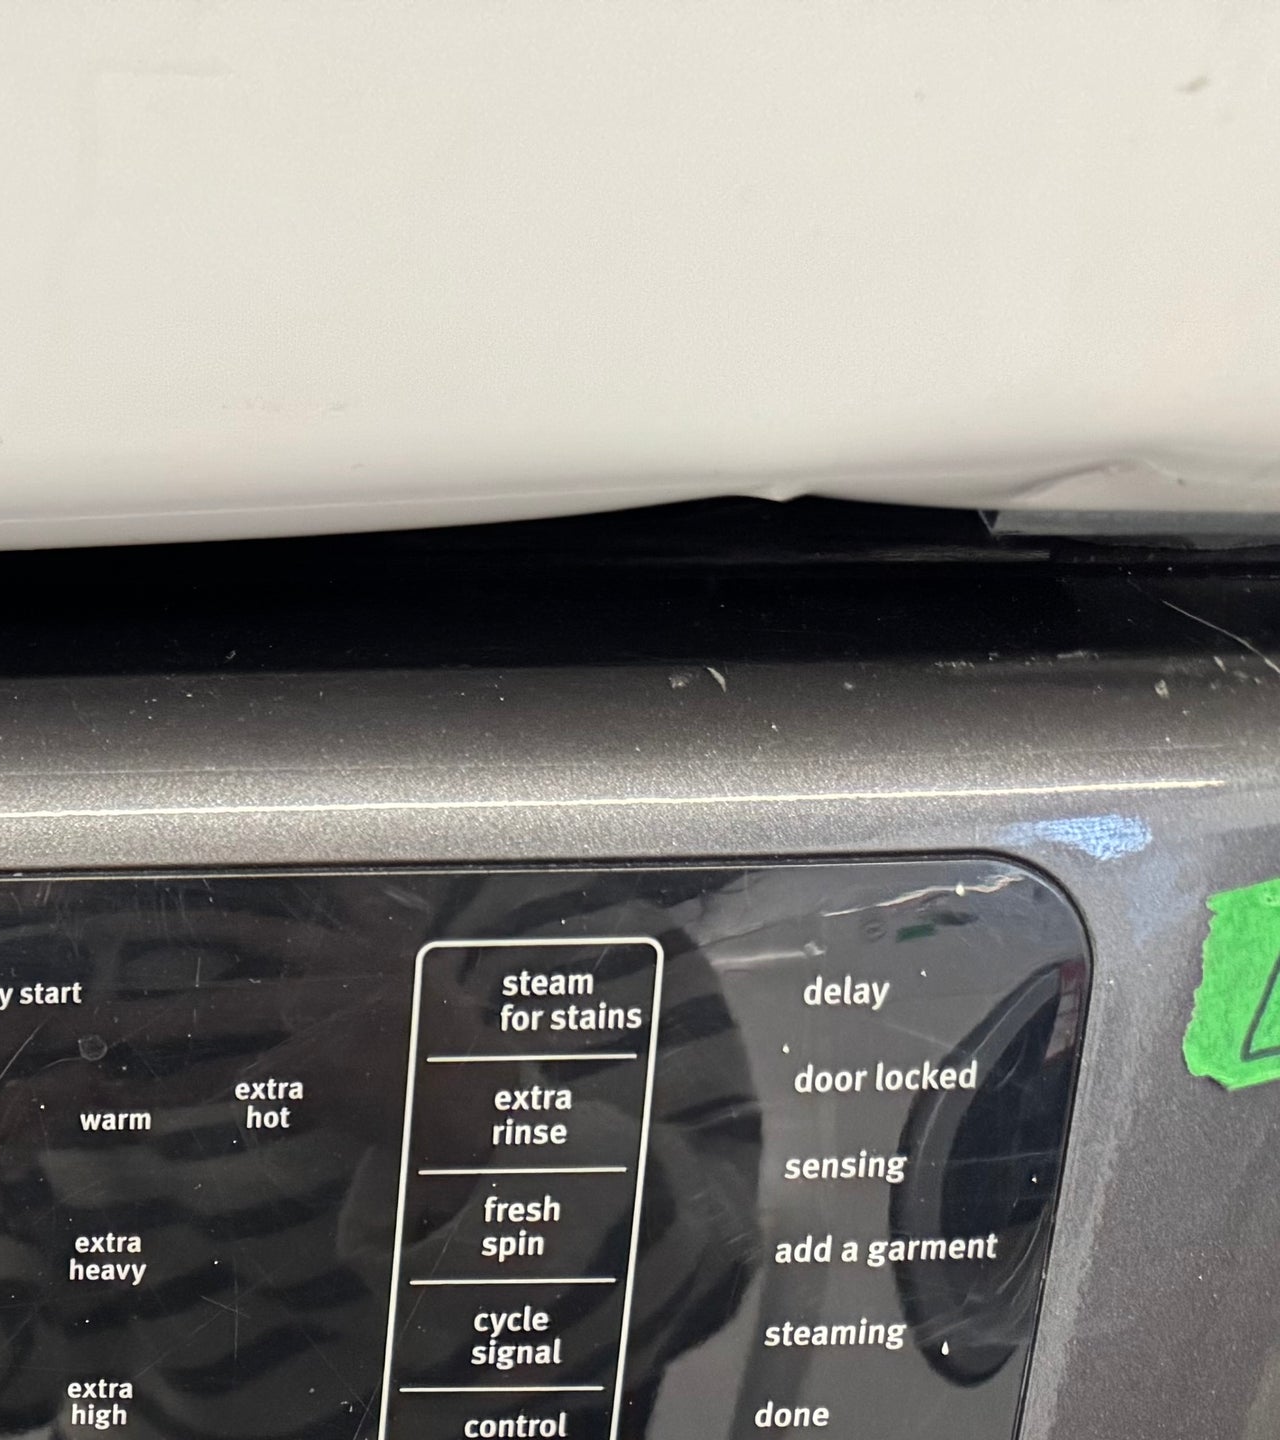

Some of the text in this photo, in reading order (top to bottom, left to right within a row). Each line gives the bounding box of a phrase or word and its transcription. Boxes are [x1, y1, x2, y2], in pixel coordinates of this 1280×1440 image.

[19, 982, 82, 1005] start
[502, 970, 594, 996] steam
[803, 975, 890, 1011] delay
[500, 1001, 642, 1032] for stains
[234, 1078, 304, 1101] extra
[794, 1059, 978, 1093] door locked
[494, 1085, 572, 1111] extra
[79, 1112, 152, 1131] warm
[246, 1104, 291, 1129] hot
[492, 1118, 568, 1145] rinse
[784, 1151, 908, 1183] sensing
[484, 1194, 561, 1223] fresh
[74, 1232, 142, 1253] extra
[481, 1229, 545, 1263] spin
[775, 1233, 999, 1268] add a garment
[69, 1257, 147, 1286] heavy
[473, 1305, 549, 1338] cycle
[764, 1317, 907, 1350] steaming
[470, 1337, 561, 1370] signal
[67, 1378, 133, 1399] extra
[71, 1403, 127, 1430] high
[464, 1411, 567, 1438] control
[754, 1400, 830, 1428] done
